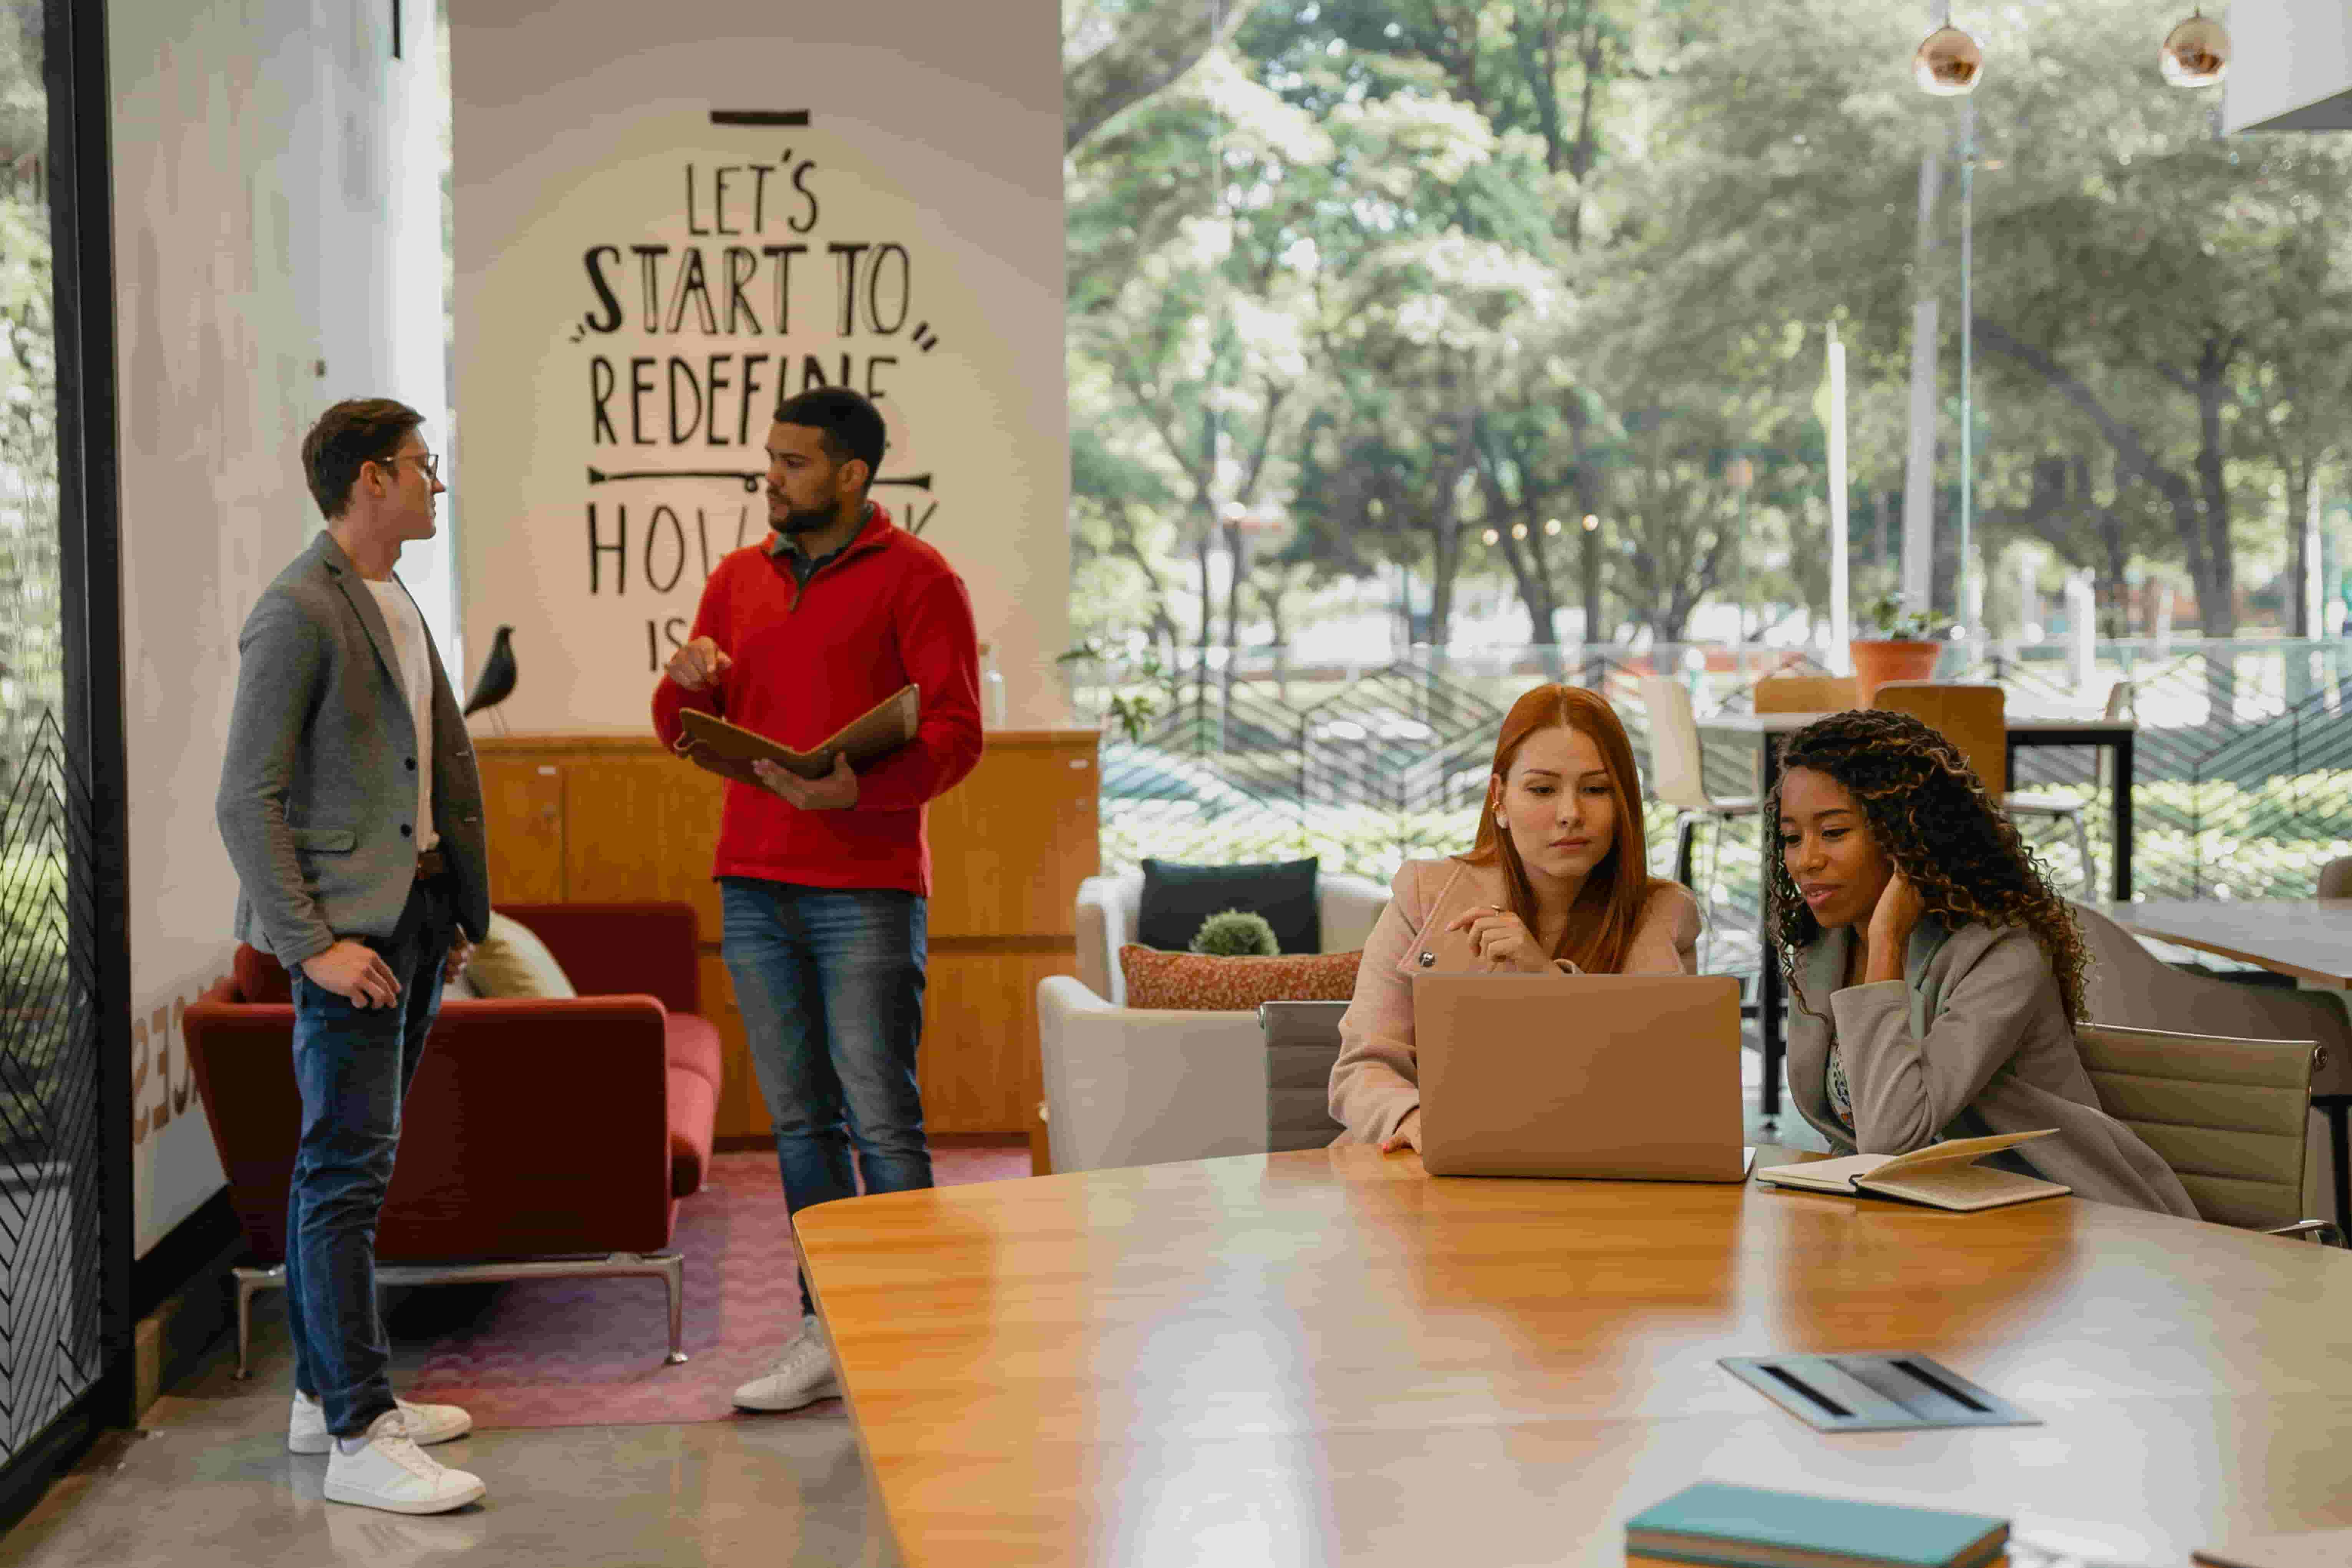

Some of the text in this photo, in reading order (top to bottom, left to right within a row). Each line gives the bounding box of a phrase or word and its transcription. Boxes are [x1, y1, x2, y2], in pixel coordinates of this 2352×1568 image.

[686, 148, 818, 236] LET'S
[583, 241, 910, 337] START TO
